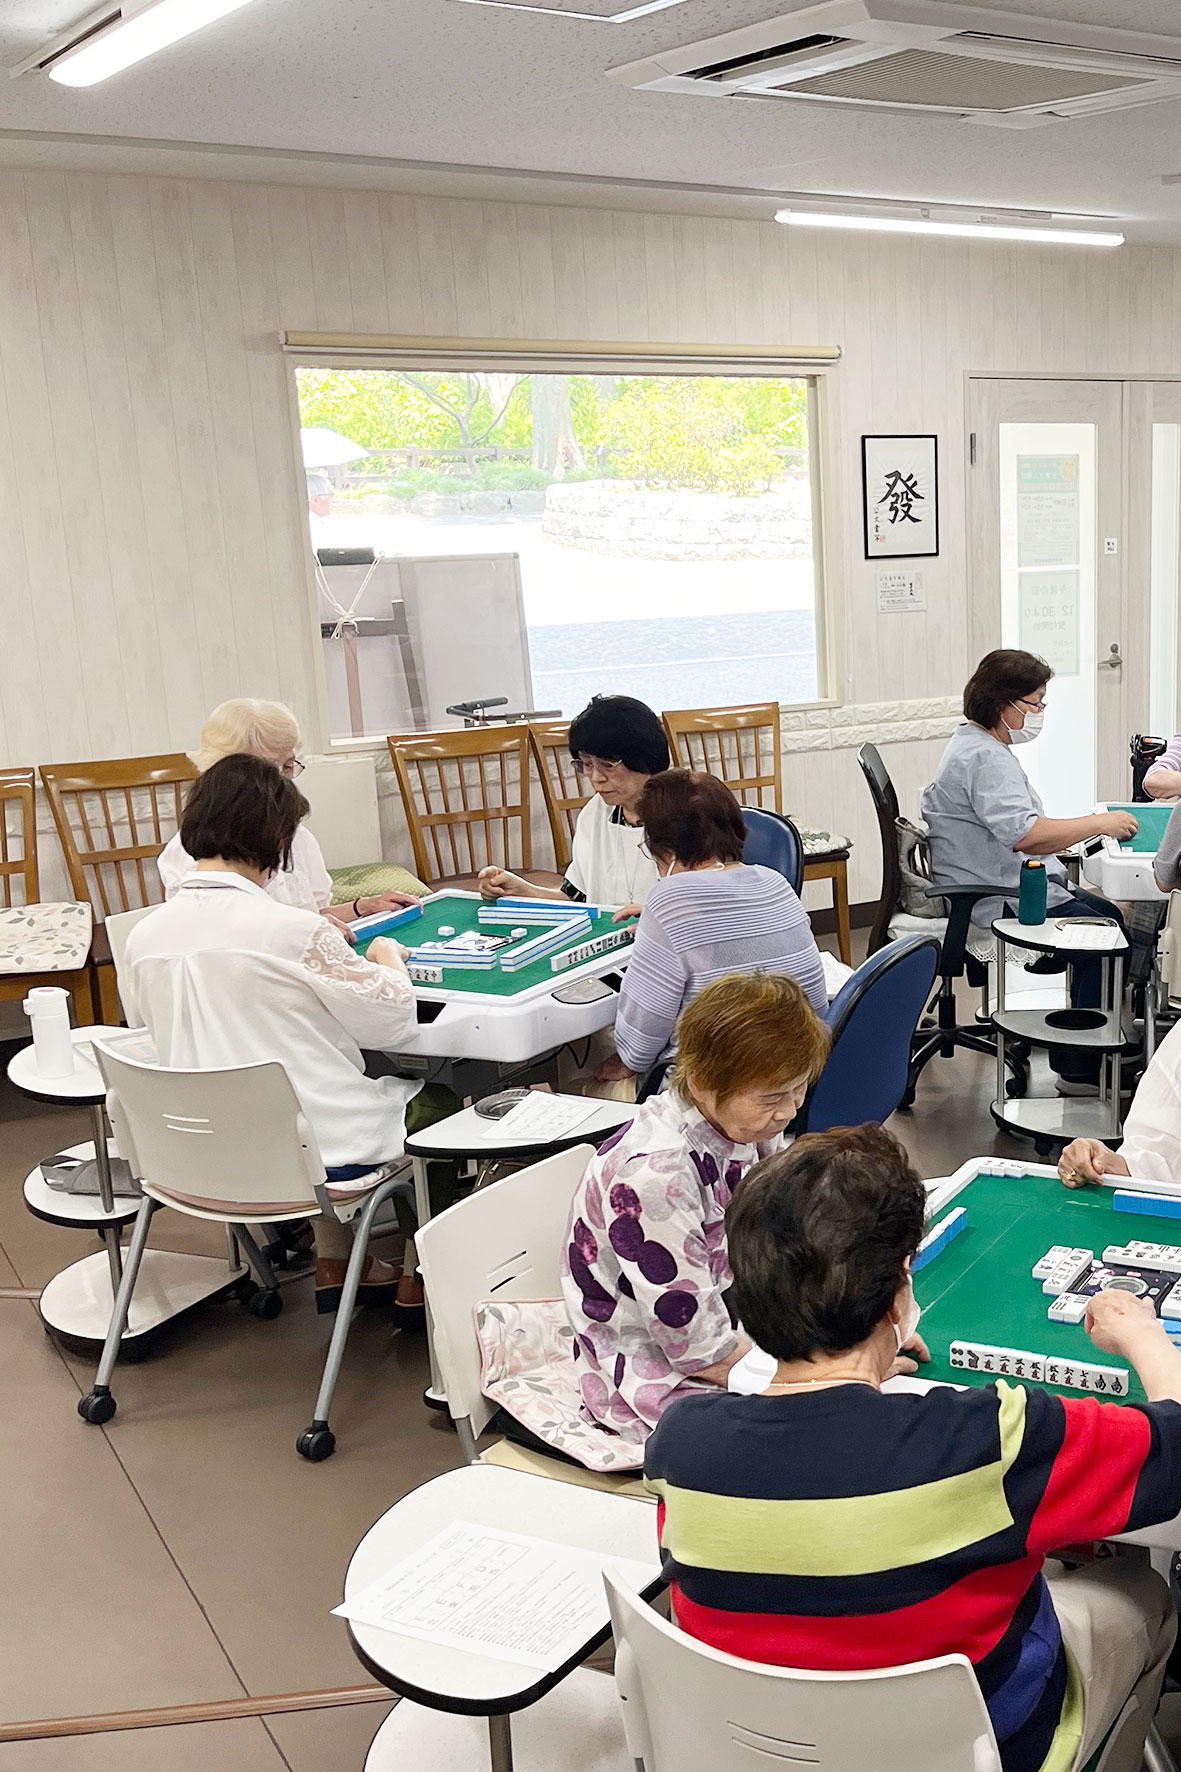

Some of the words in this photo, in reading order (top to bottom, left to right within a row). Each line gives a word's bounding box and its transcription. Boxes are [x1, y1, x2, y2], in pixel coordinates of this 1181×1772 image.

[877, 470, 925, 524] 發
[1094, 1374, 1107, 1392] 南
[1110, 1377, 1123, 1394] 南
